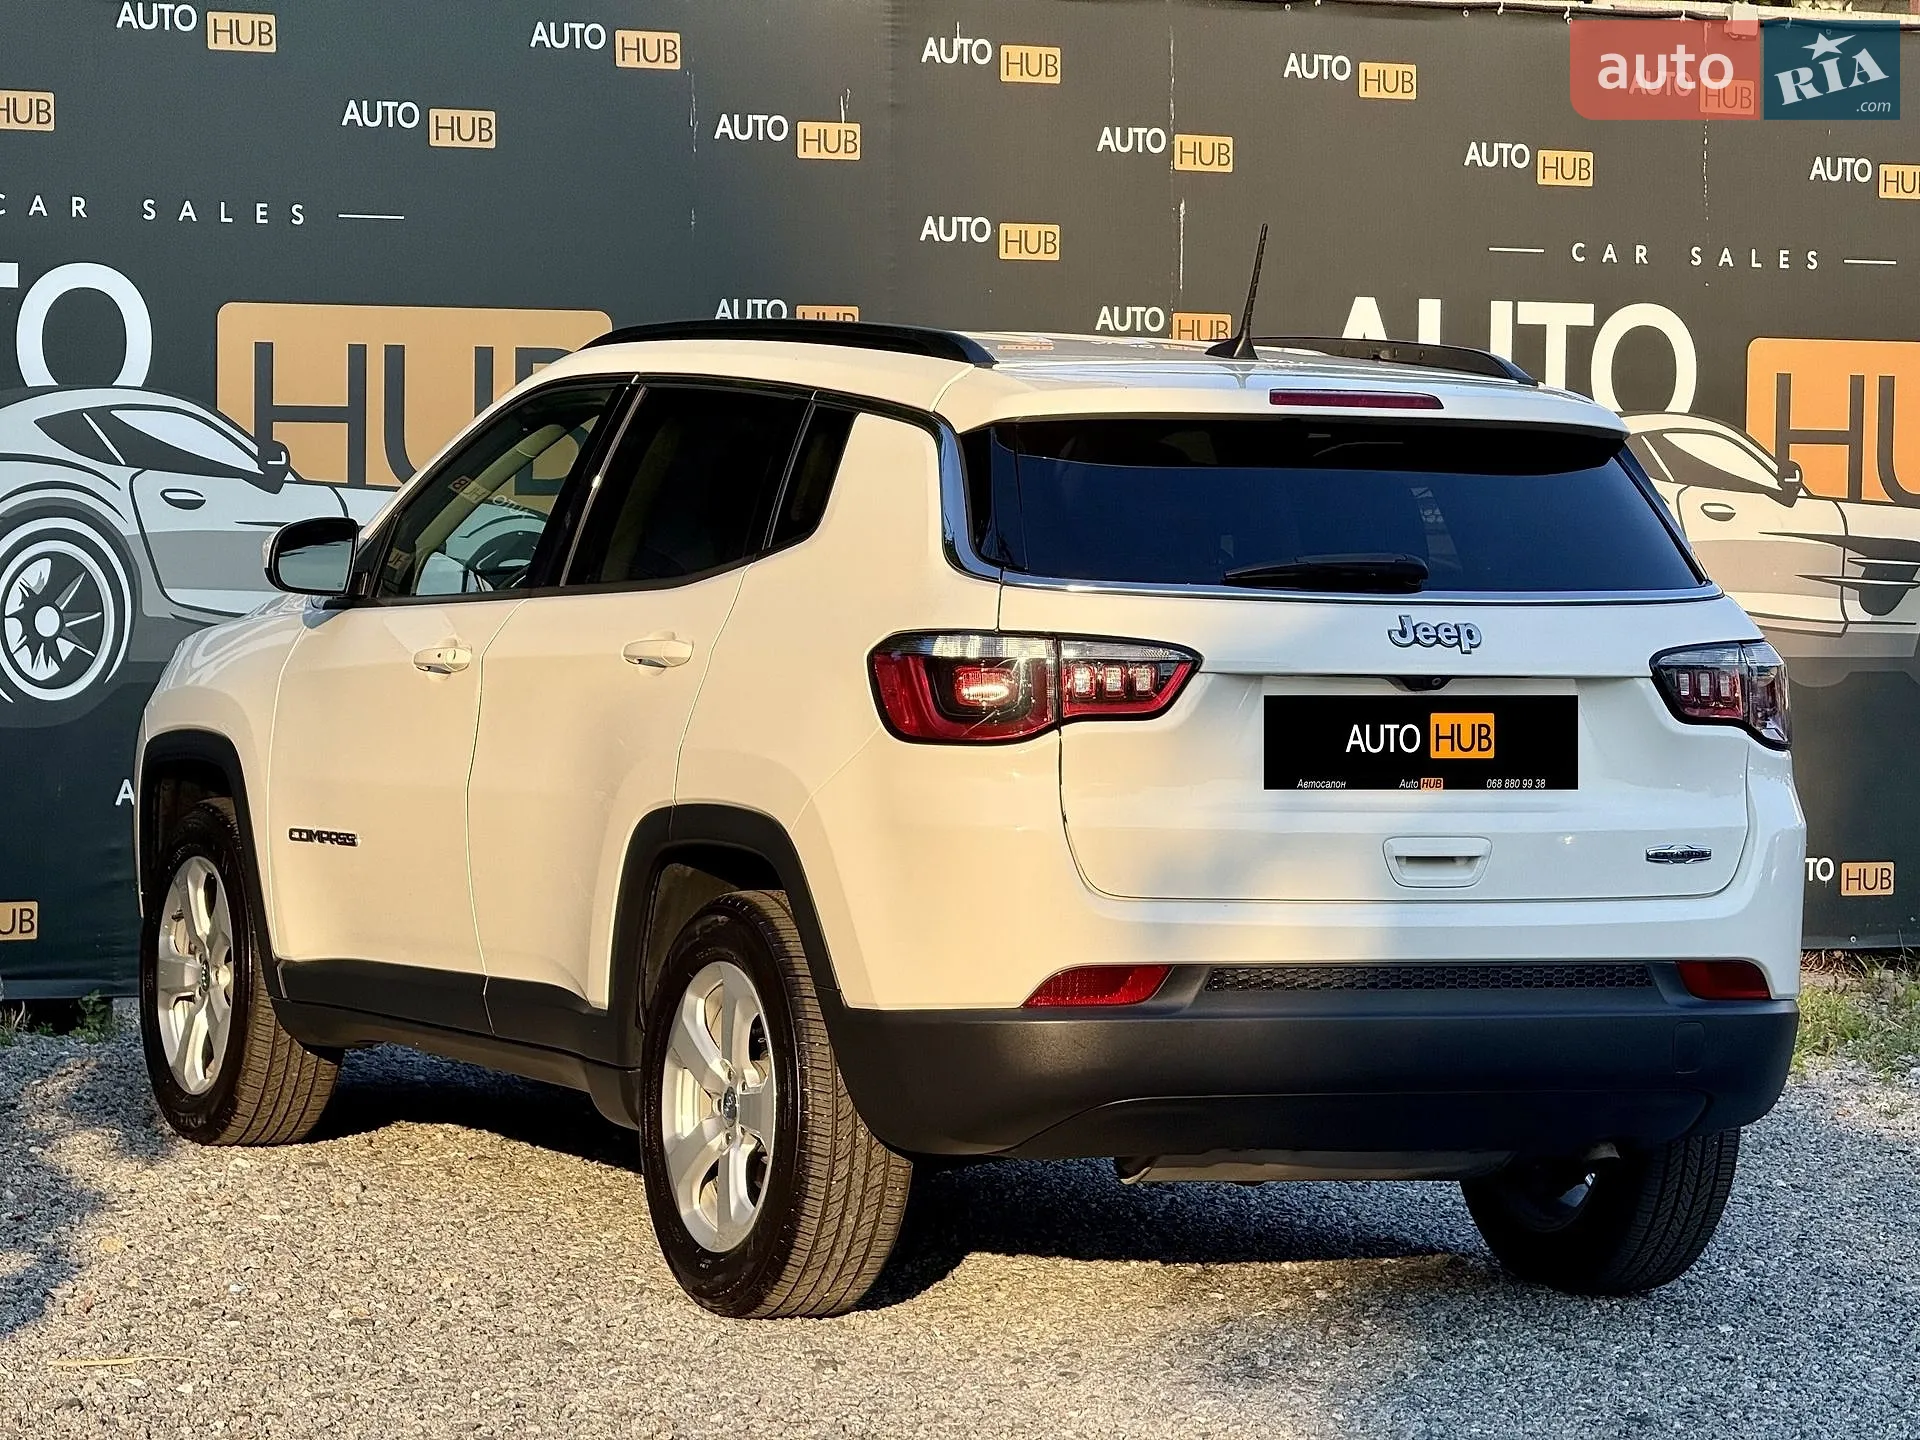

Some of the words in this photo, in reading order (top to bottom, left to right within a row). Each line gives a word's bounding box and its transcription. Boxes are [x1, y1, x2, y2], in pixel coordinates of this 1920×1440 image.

[116, 2, 197, 31] AUTO
[213, 19, 273, 47] HUB
[530, 22, 606, 49] AUTO
[620, 36, 678, 64] HUB
[921, 38, 992, 64] AUTO
[1006, 52, 1058, 78] HUB
[1284, 53, 1351, 80] AUTO
[1364, 68, 1414, 94] HUB
[1704, 83, 1752, 109] HUB
[341, 100, 419, 128] AUTO
[434, 115, 493, 143] HUB
[714, 114, 788, 141] AUTO
[803, 127, 858, 154] HUB
[1097, 127, 1166, 153] AUTO
[1179, 140, 1231, 167] HUB
[1464, 142, 1530, 168] AUTO
[1542, 155, 1591, 181] HUB
[1809, 156, 1872, 182] AUTO
[1883, 170, 1920, 193] HU
[143, 199, 304, 225] SALES
[920, 216, 991, 242] AUTO
[1005, 229, 1057, 255] HUB
[1572, 243, 1648, 264] CAR
[1691, 247, 1817, 269] SALES
[715, 299, 787, 319] AUTO
[1095, 306, 1165, 332] AUTO
[1177, 319, 1229, 340] HUB
[1388, 615, 1482, 654] Jeep
[1845, 868, 1892, 891] HUB
